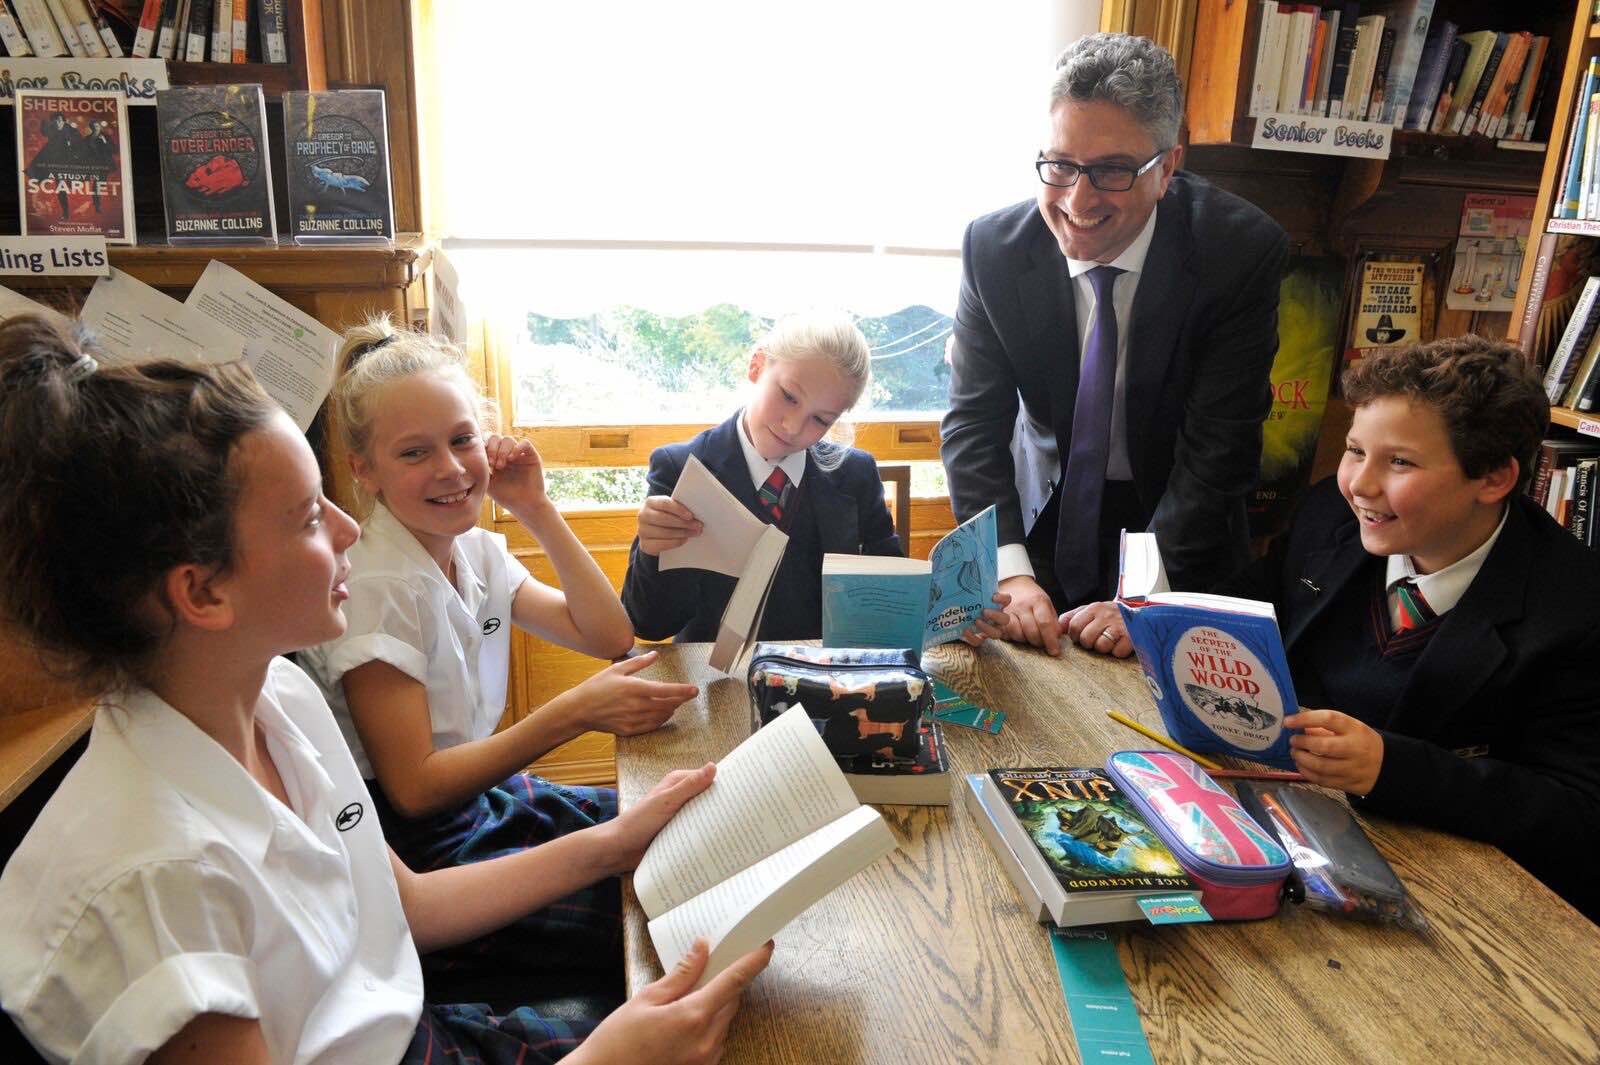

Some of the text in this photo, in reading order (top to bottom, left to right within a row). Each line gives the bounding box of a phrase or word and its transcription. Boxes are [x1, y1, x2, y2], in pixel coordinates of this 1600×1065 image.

[24, 98, 116, 112] SHERLOCK
[1262, 118, 1384, 149] Senior Books
[171, 138, 255, 153] OVERLANDER
[297, 142, 344, 155] PROPHECY
[351, 141, 377, 154] BANE
[48, 172, 55, 180] A
[28, 178, 120, 196] SCARLET
[176, 217, 263, 232] SUZANNE COLLINS
[299, 218, 383, 232] SUZANNE COLLINS
[1550, 221, 1581, 230] Christian
[50, 247, 105, 268] Lists
[1370, 286, 1410, 295] THE CASE
[1377, 295, 1412, 304] DEADLY
[1362, 305, 1416, 314] DESPERADOS
[932, 615, 972, 632] Clocks
[1202, 630, 1217, 638] THE
[1191, 636, 1237, 650] SECRETS
[1215, 648, 1232, 656] THE
[1187, 651, 1252, 676] WILD
[1190, 669, 1260, 695] WOOD
[1003, 779, 1116, 802] JINX
[1069, 878, 1189, 888] SAGE BLACKWOOD
